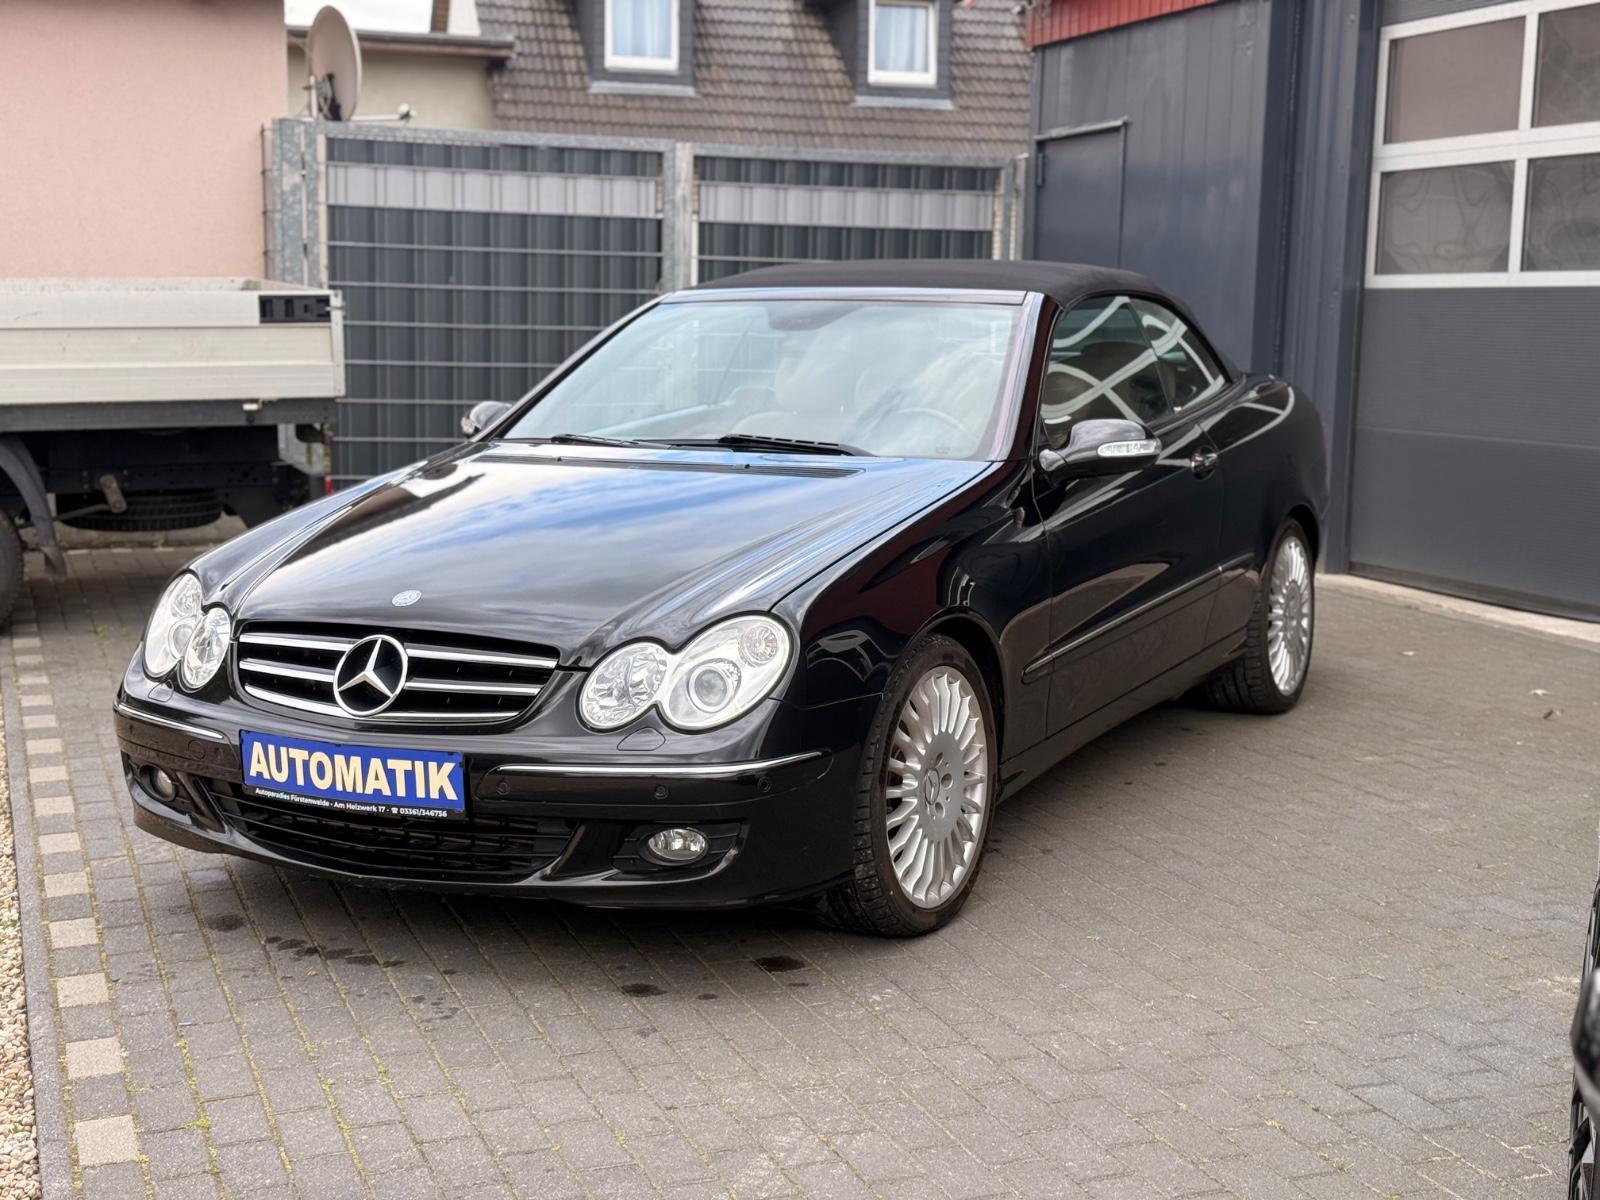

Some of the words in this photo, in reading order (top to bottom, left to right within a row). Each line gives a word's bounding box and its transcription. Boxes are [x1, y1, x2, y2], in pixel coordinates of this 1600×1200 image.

[250, 741, 458, 800] AUTOMATIK
[255, 787, 290, 800] Autoparadies
[291, 794, 329, 807] Fürstenwalde
[334, 801, 345, 809] Am
[346, 803, 377, 812] Heizwerk
